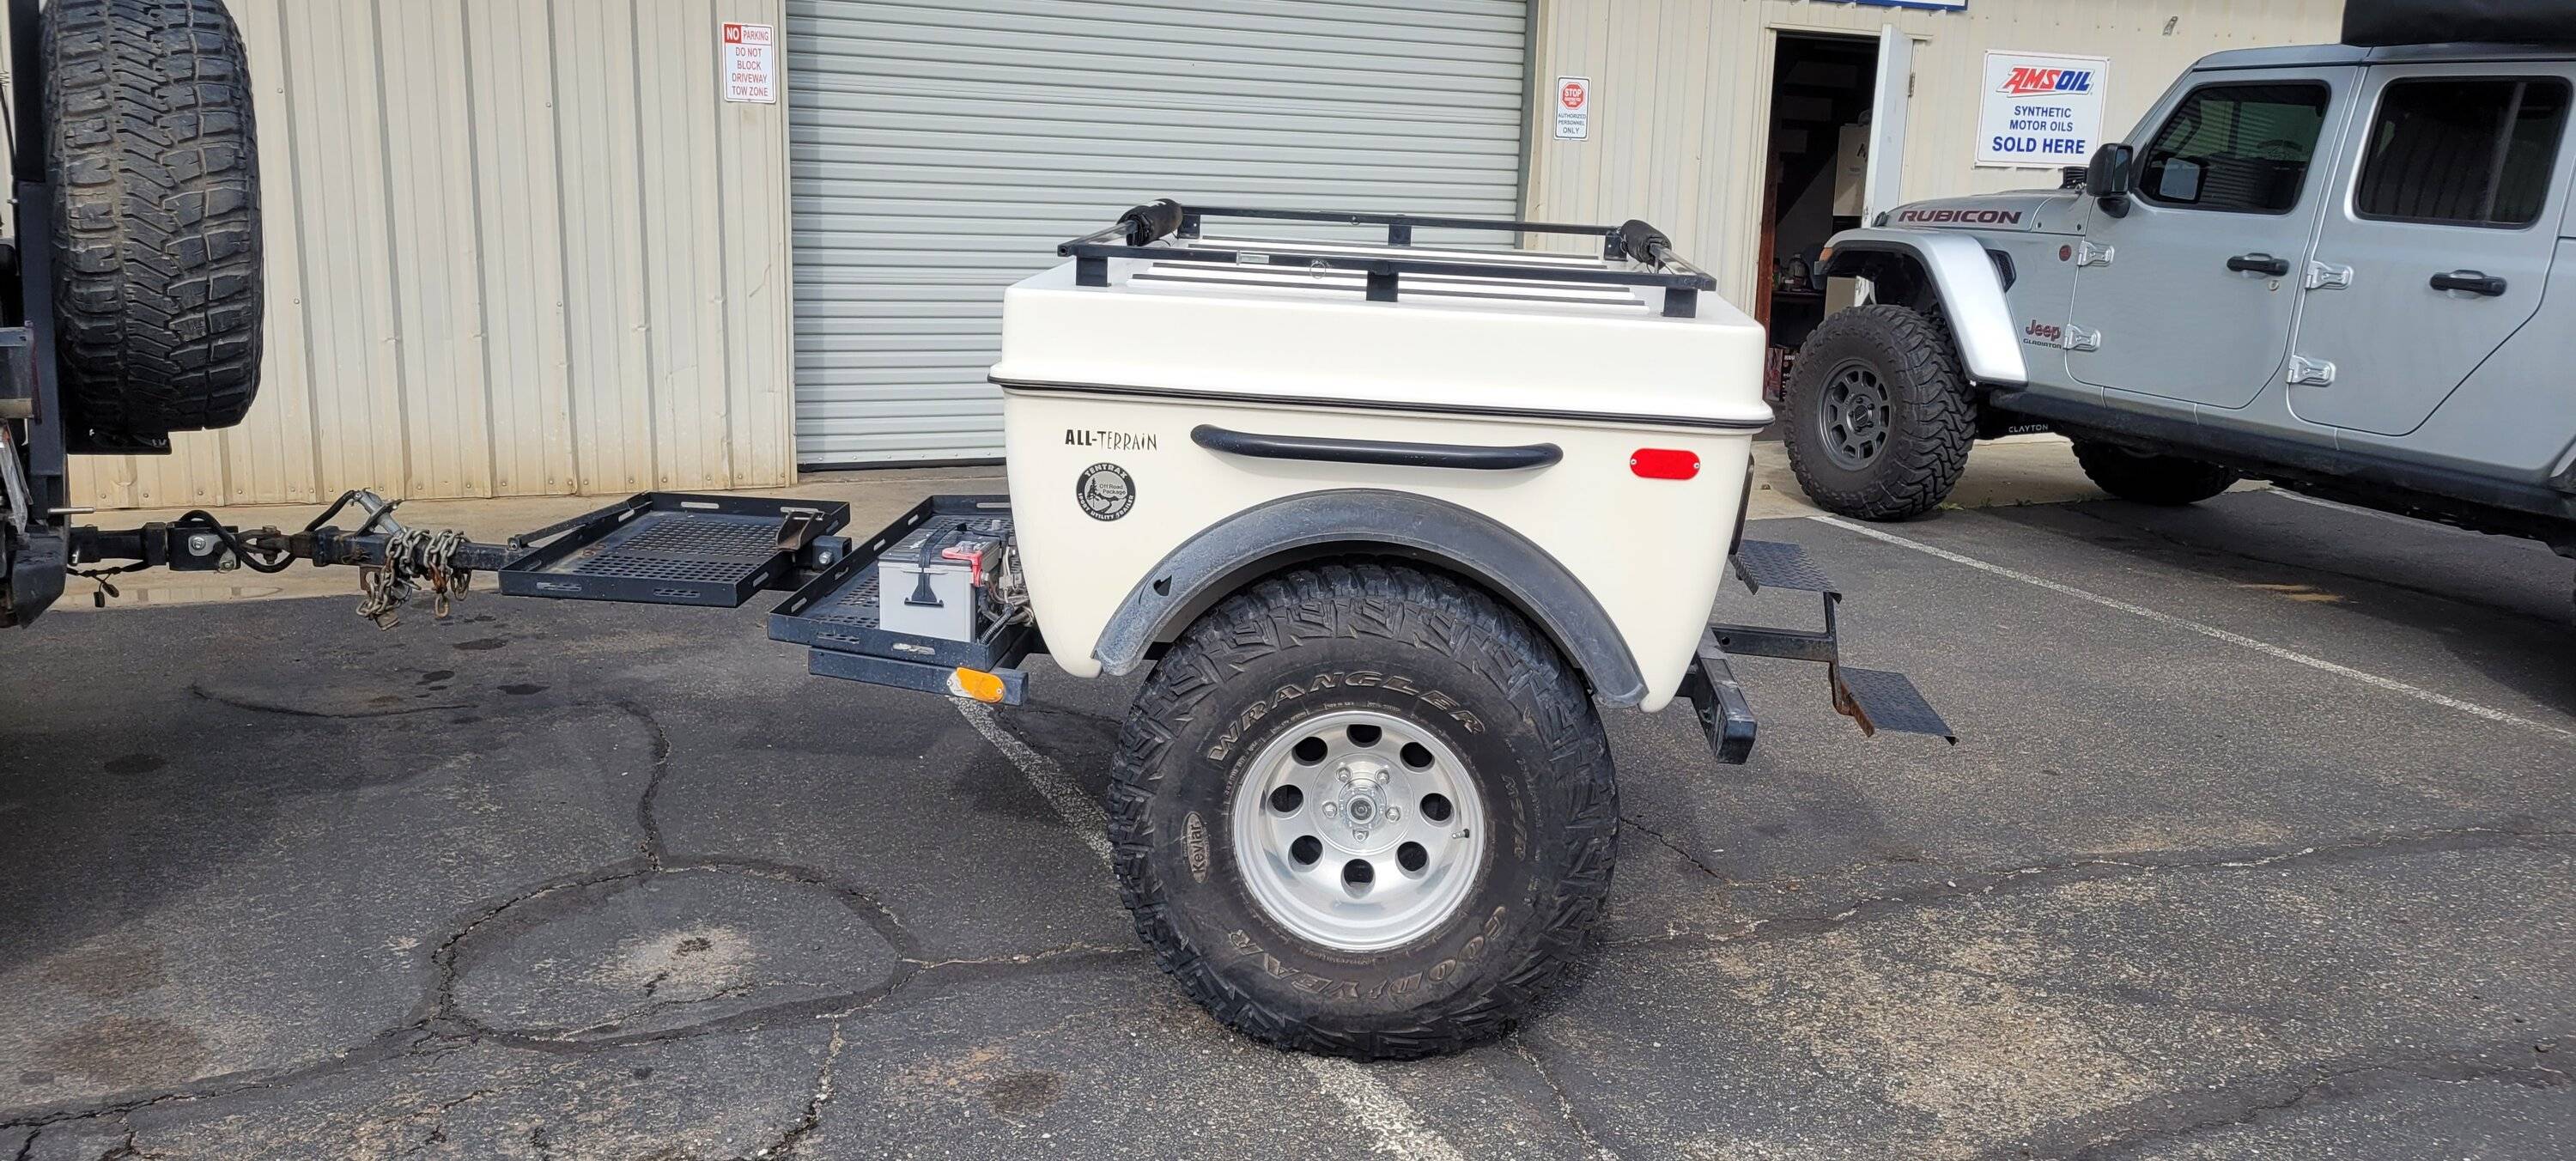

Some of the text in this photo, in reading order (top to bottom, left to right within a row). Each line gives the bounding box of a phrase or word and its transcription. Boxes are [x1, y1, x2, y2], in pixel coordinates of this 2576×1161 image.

[726, 27, 769, 40] NO PARKING
[735, 47, 762, 58] DO NOT
[737, 60, 762, 70] BLOCK
[732, 73, 767, 83] DRIVEWAY
[2002, 67, 2092, 94] AMSOIL
[732, 86, 769, 96] TOW ZONE
[1564, 88, 1583, 97] STOP
[2014, 105, 2072, 119] SYNTHETIC
[2009, 119, 2074, 132] MOTOR OILS
[1992, 136, 2086, 154] SOLD HERE
[1898, 210, 2023, 224] RUBICON
[2025, 319, 2062, 342] Jeep
[2022, 338, 2063, 350] GLADIATOR
[2008, 423, 2049, 433] CLAYTON
[1084, 464, 1127, 478] TENTRAX
[1078, 492, 1134, 520] SPORT UTILITY TRAILER
[1207, 671, 1486, 763] WRANGLER
[1189, 824, 1206, 874] Kevlar
[1228, 906, 1506, 1000] GOODYEAR
